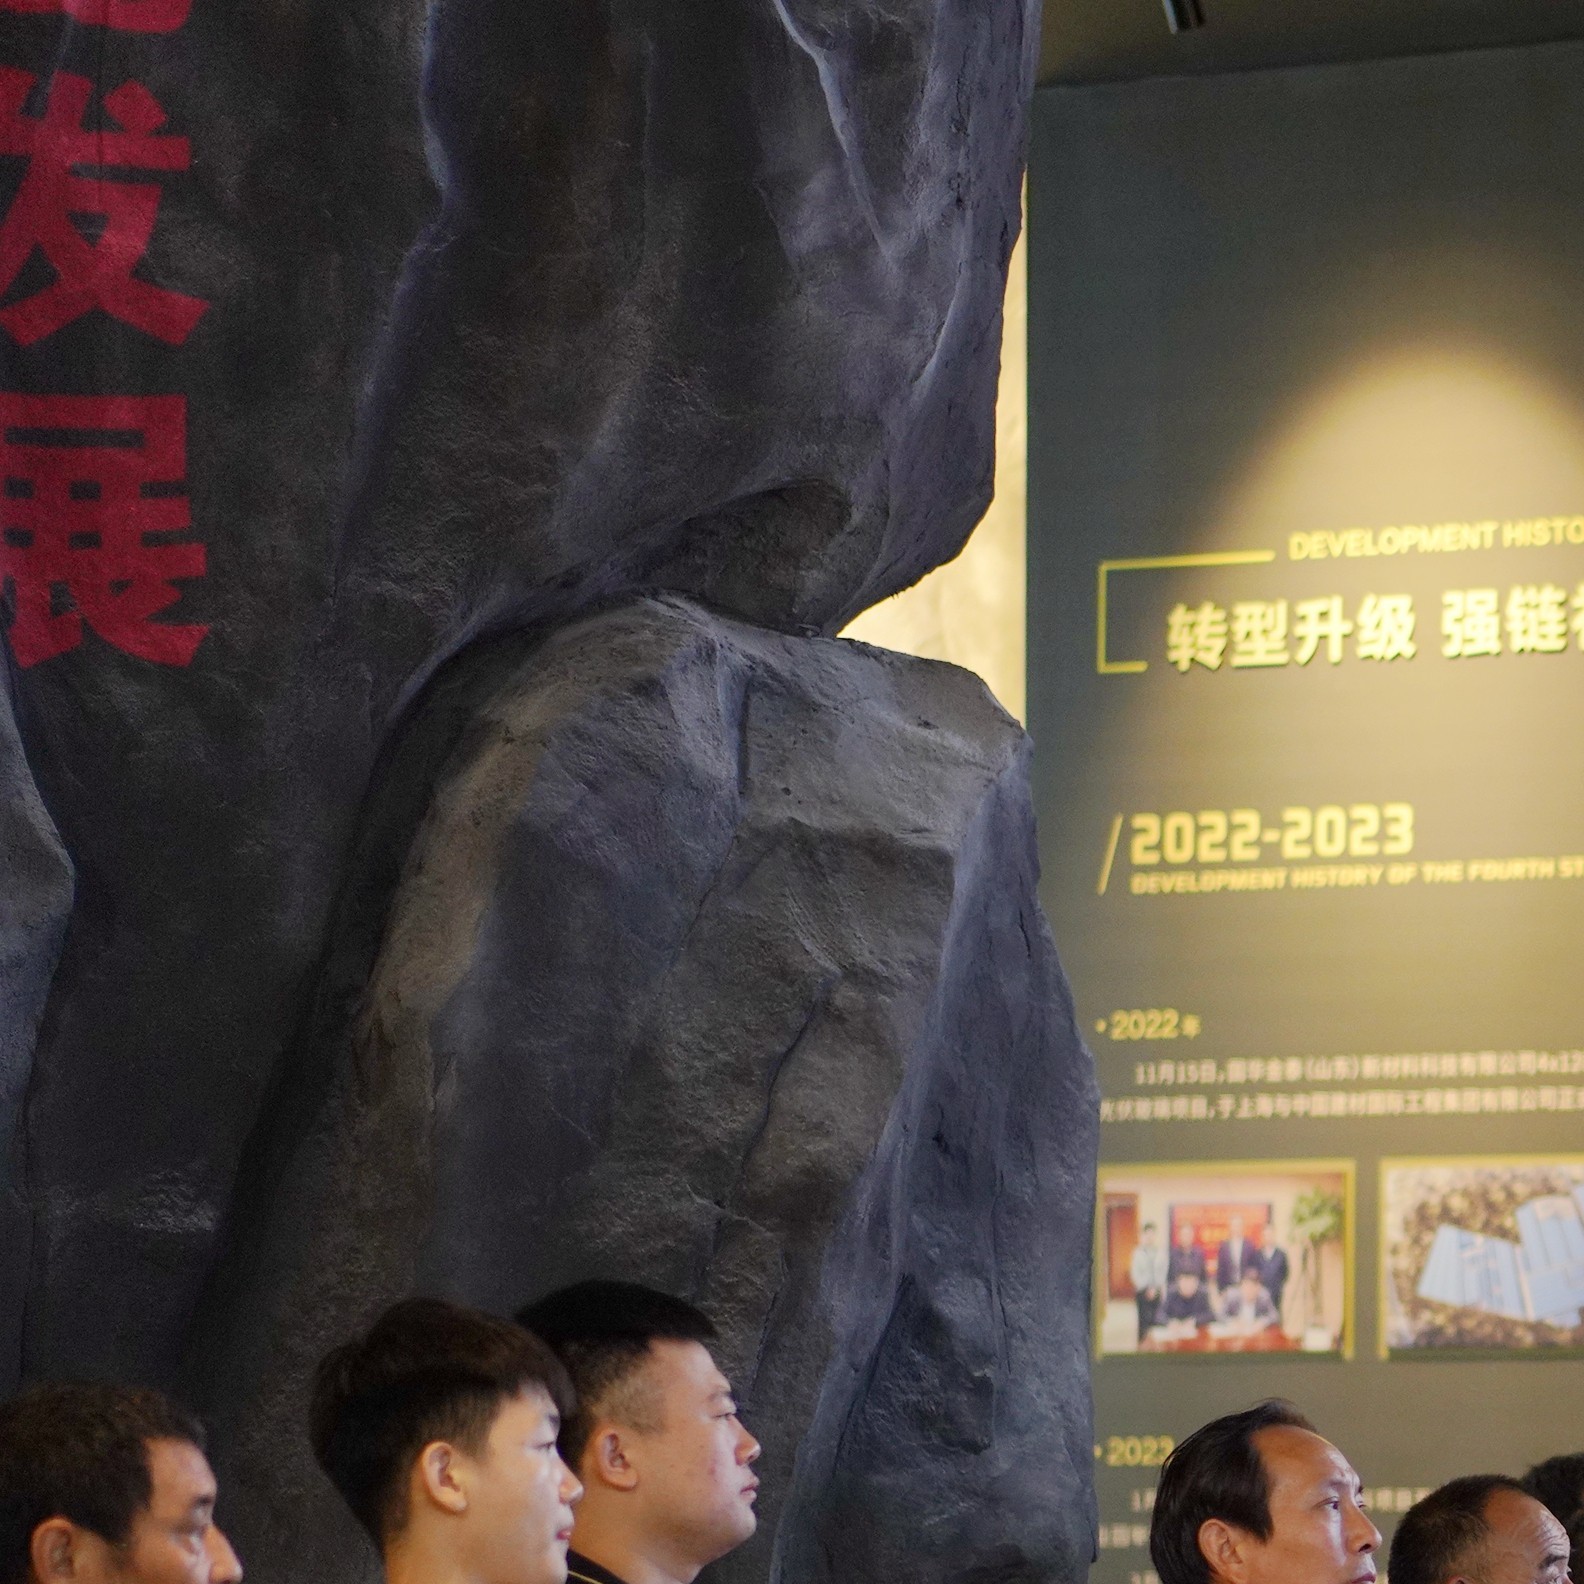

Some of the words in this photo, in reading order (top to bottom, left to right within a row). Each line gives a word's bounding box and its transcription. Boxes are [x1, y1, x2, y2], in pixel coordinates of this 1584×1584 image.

[0, 0, 208, 668] 发展
[1289, 521, 1496, 561] DEVELOPMENT
[1166, 593, 1418, 674] 转型升级
[1129, 802, 1416, 866] 2022-2023
[1130, 867, 1287, 895] DEVELOPMENT
[1291, 864, 1381, 888] HISTORY
[1387, 862, 1418, 885] OF
[1421, 860, 1464, 884] THE
[1468, 857, 1556, 881] FOURTH
